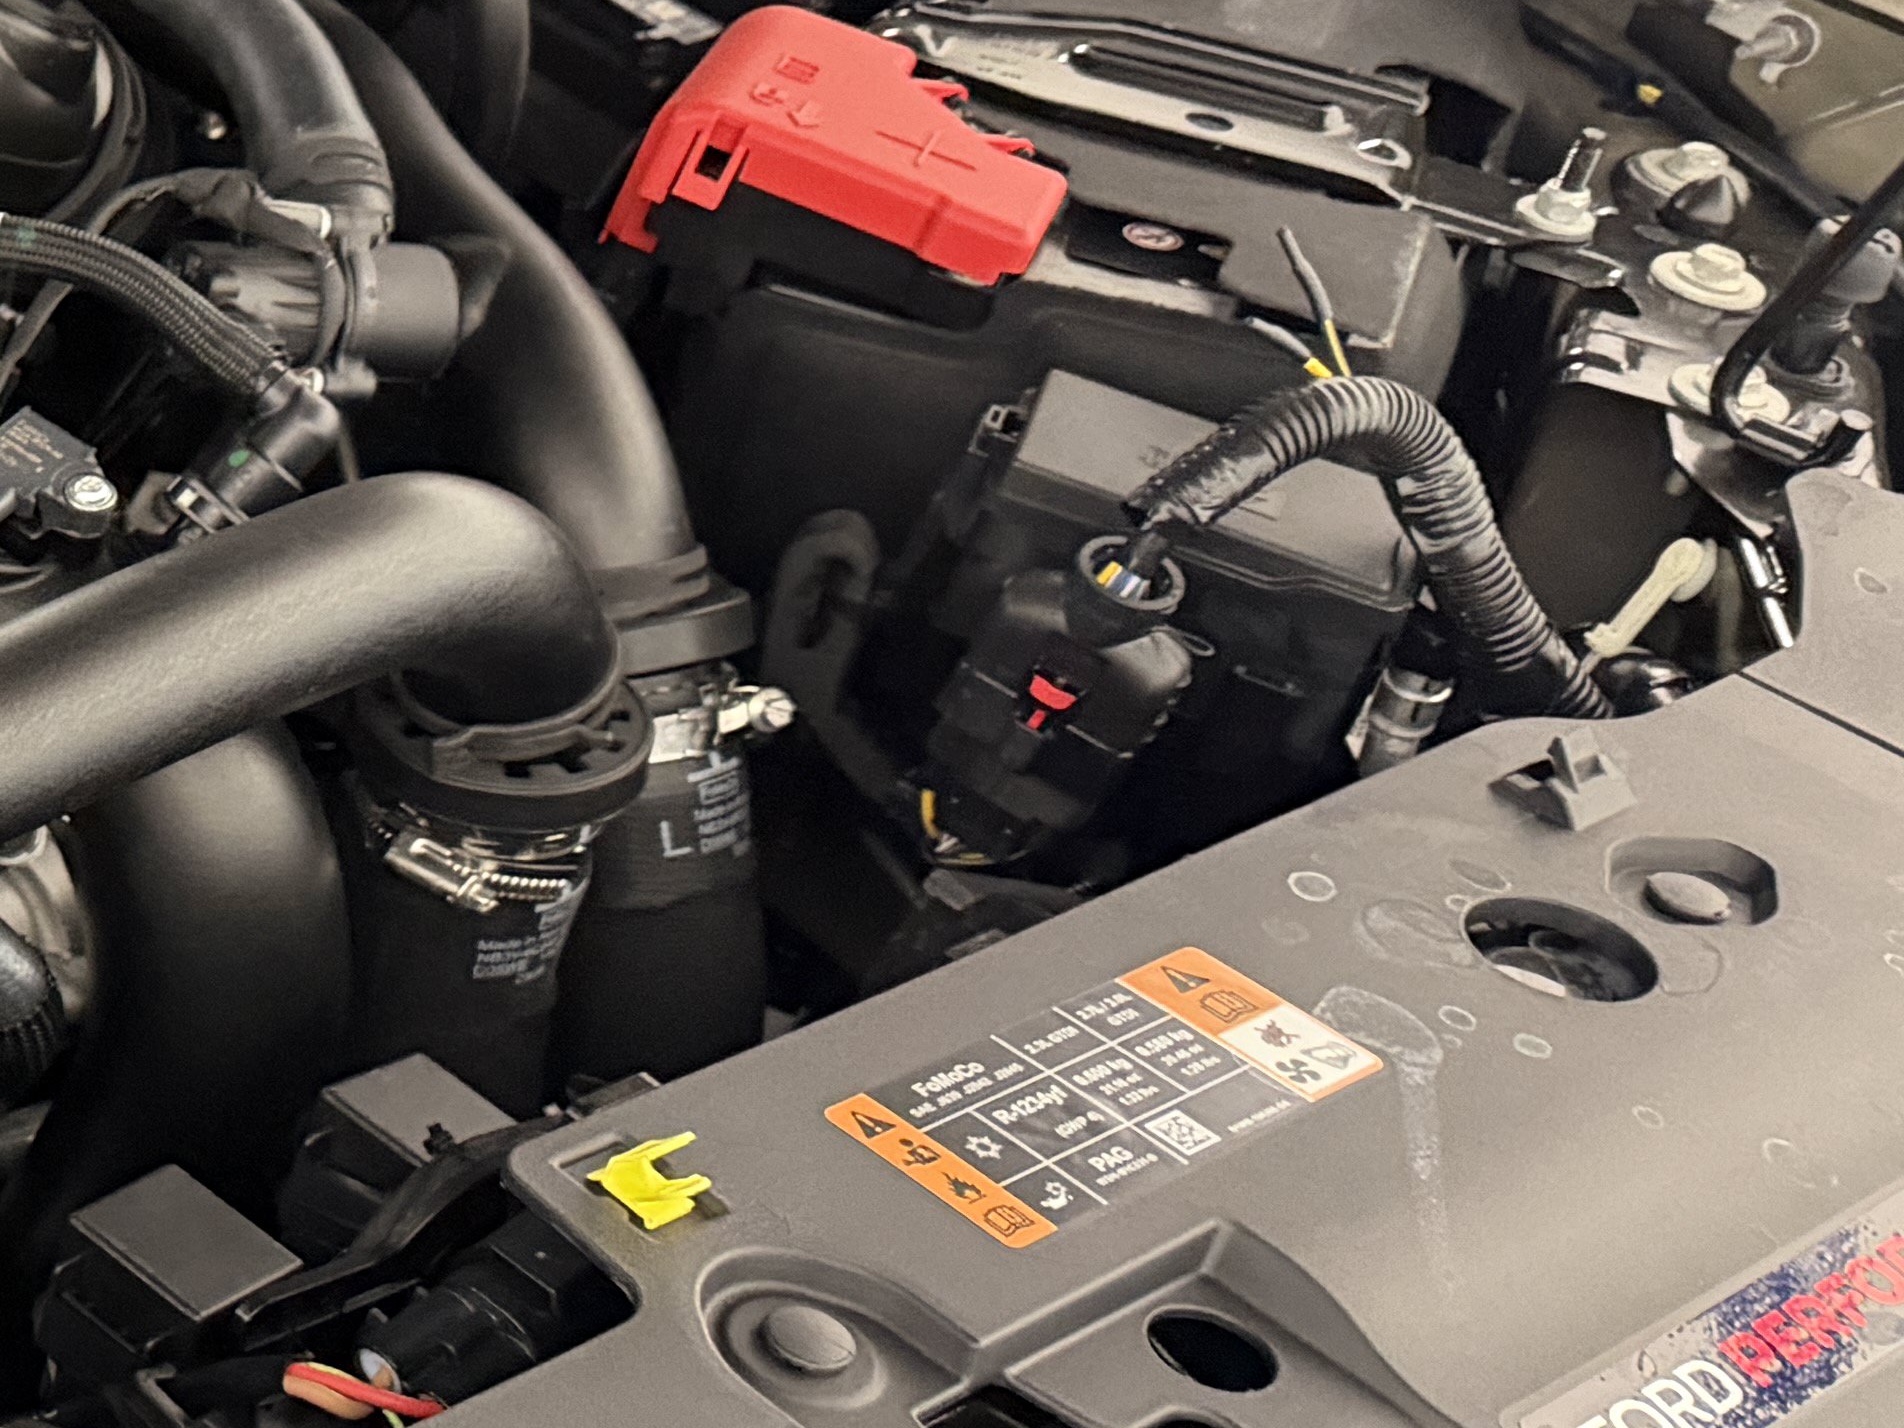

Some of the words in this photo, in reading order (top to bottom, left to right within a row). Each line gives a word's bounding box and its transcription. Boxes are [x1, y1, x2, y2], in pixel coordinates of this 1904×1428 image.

[660, 820, 694, 858] L
[1166, 1028, 1194, 1044] kg
[910, 1059, 986, 1098] FoMoCo
[1105, 1057, 1132, 1072] kg
[990, 1085, 1072, 1127] R-1234yf
[1087, 1146, 1134, 1172] PAG
